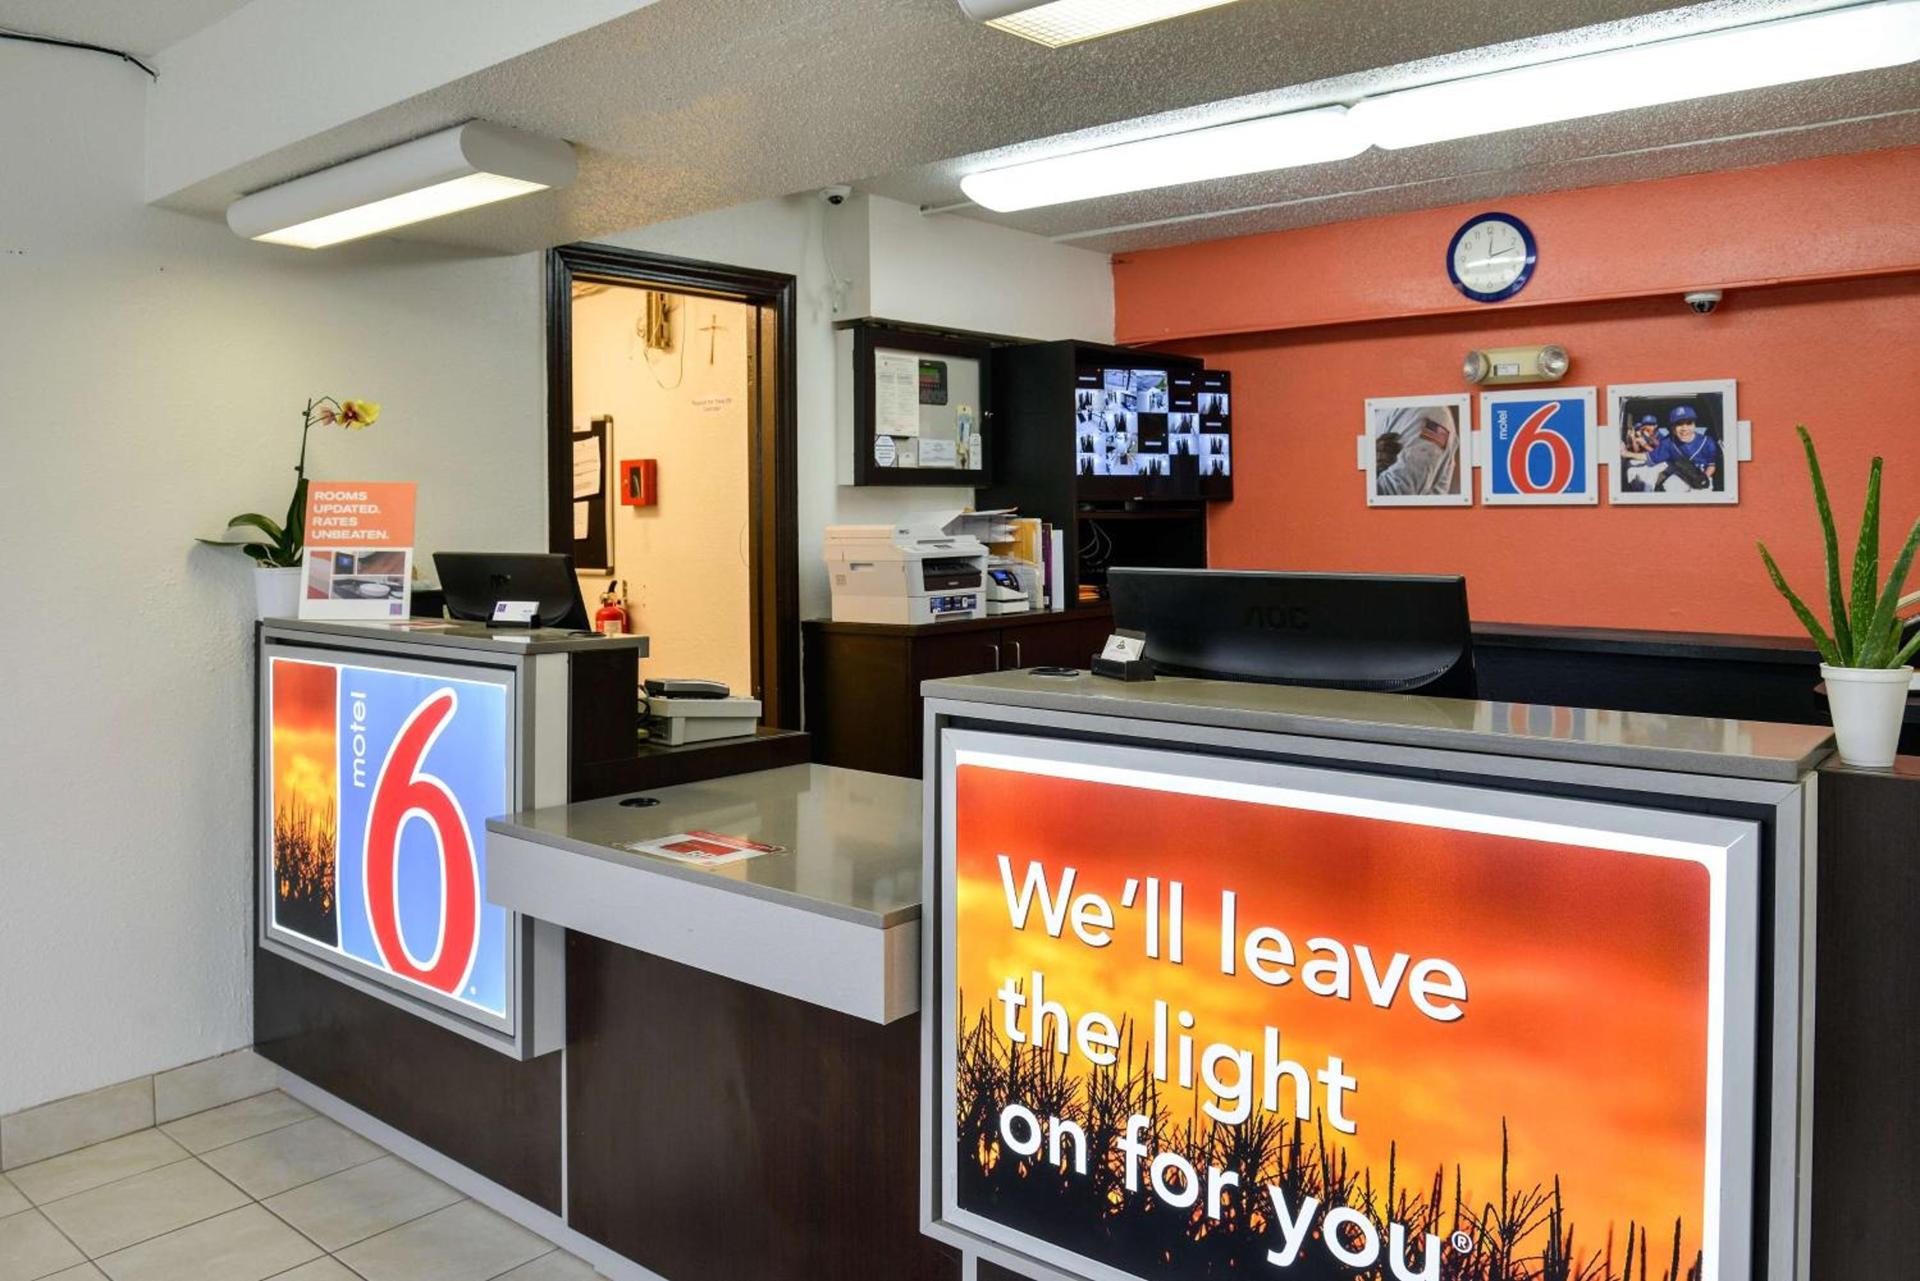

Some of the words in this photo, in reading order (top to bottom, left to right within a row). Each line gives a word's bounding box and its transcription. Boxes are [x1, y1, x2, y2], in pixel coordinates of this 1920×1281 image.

[1497, 410, 1508, 440] motel
[1507, 402, 1574, 494] 6
[311, 517, 359, 527] RATES
[311, 530, 390, 540] UNBEATEN.
[312, 504, 382, 514] UPDATED.
[313, 491, 369, 501] ROOMS
[350, 690, 367, 788] motel
[362, 687, 481, 997] 6
[997, 853, 1183, 964] We'll
[1220, 890, 1469, 1023] leave
[997, 971, 1121, 1066] the
[1153, 1000, 1358, 1135] light
[999, 1103, 1088, 1175] on
[1117, 1115, 1240, 1221] for
